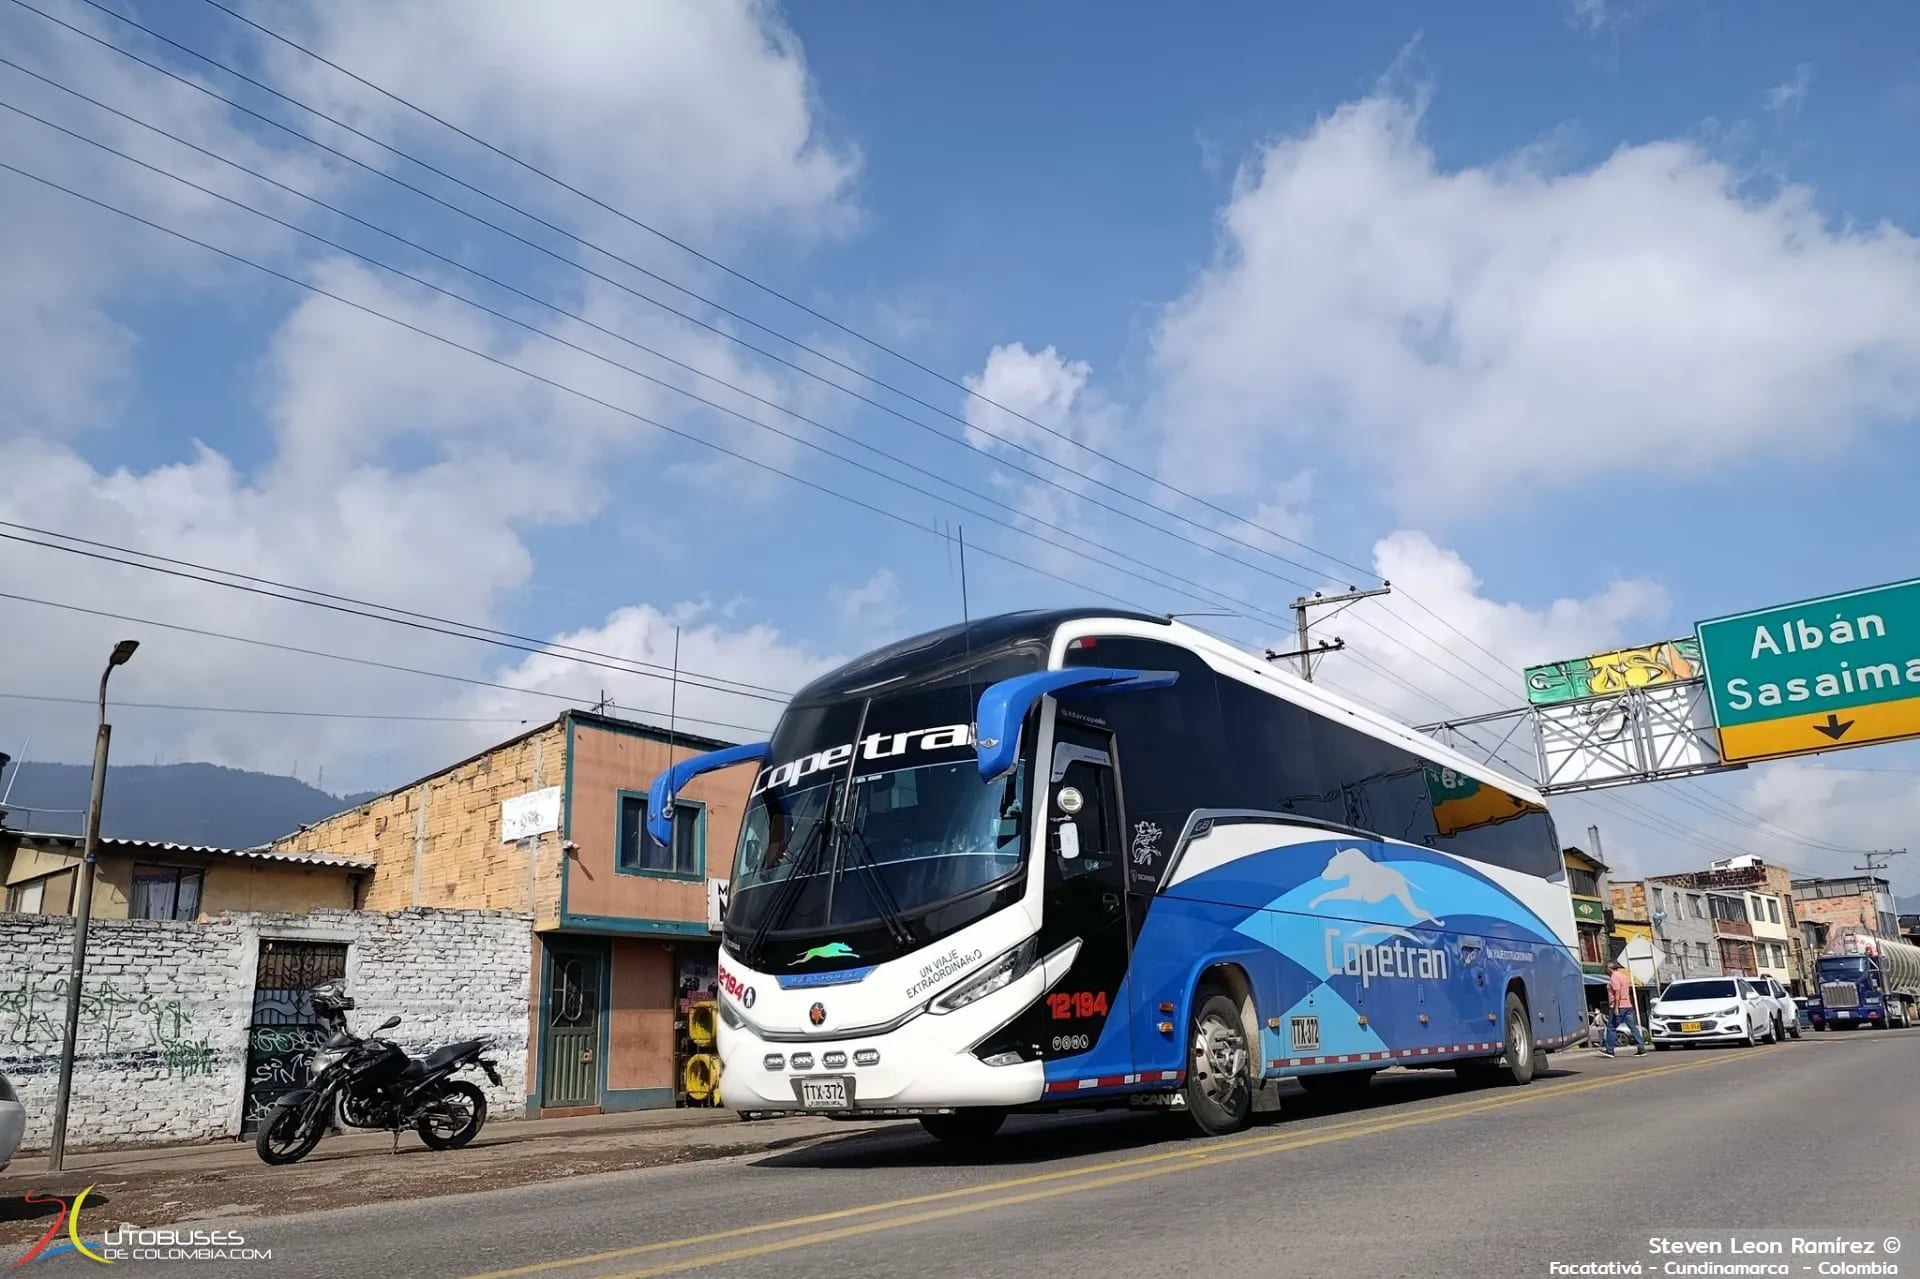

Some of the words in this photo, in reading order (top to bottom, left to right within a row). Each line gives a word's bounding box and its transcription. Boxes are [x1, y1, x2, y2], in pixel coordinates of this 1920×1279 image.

[1751, 613, 1886, 659] Albán
[1727, 658, 1920, 711] Sasaima
[750, 723, 977, 799] Copetra
[906, 949, 983, 999] EXTRAORDINARIO
[920, 964, 933, 978] UN
[933, 949, 959, 969] VIAJE
[1325, 928, 1447, 988] Copetran
[718, 965, 744, 1001] 2194
[1047, 991, 1108, 1020] 12194
[1130, 1093, 1186, 1106] SCANIA
